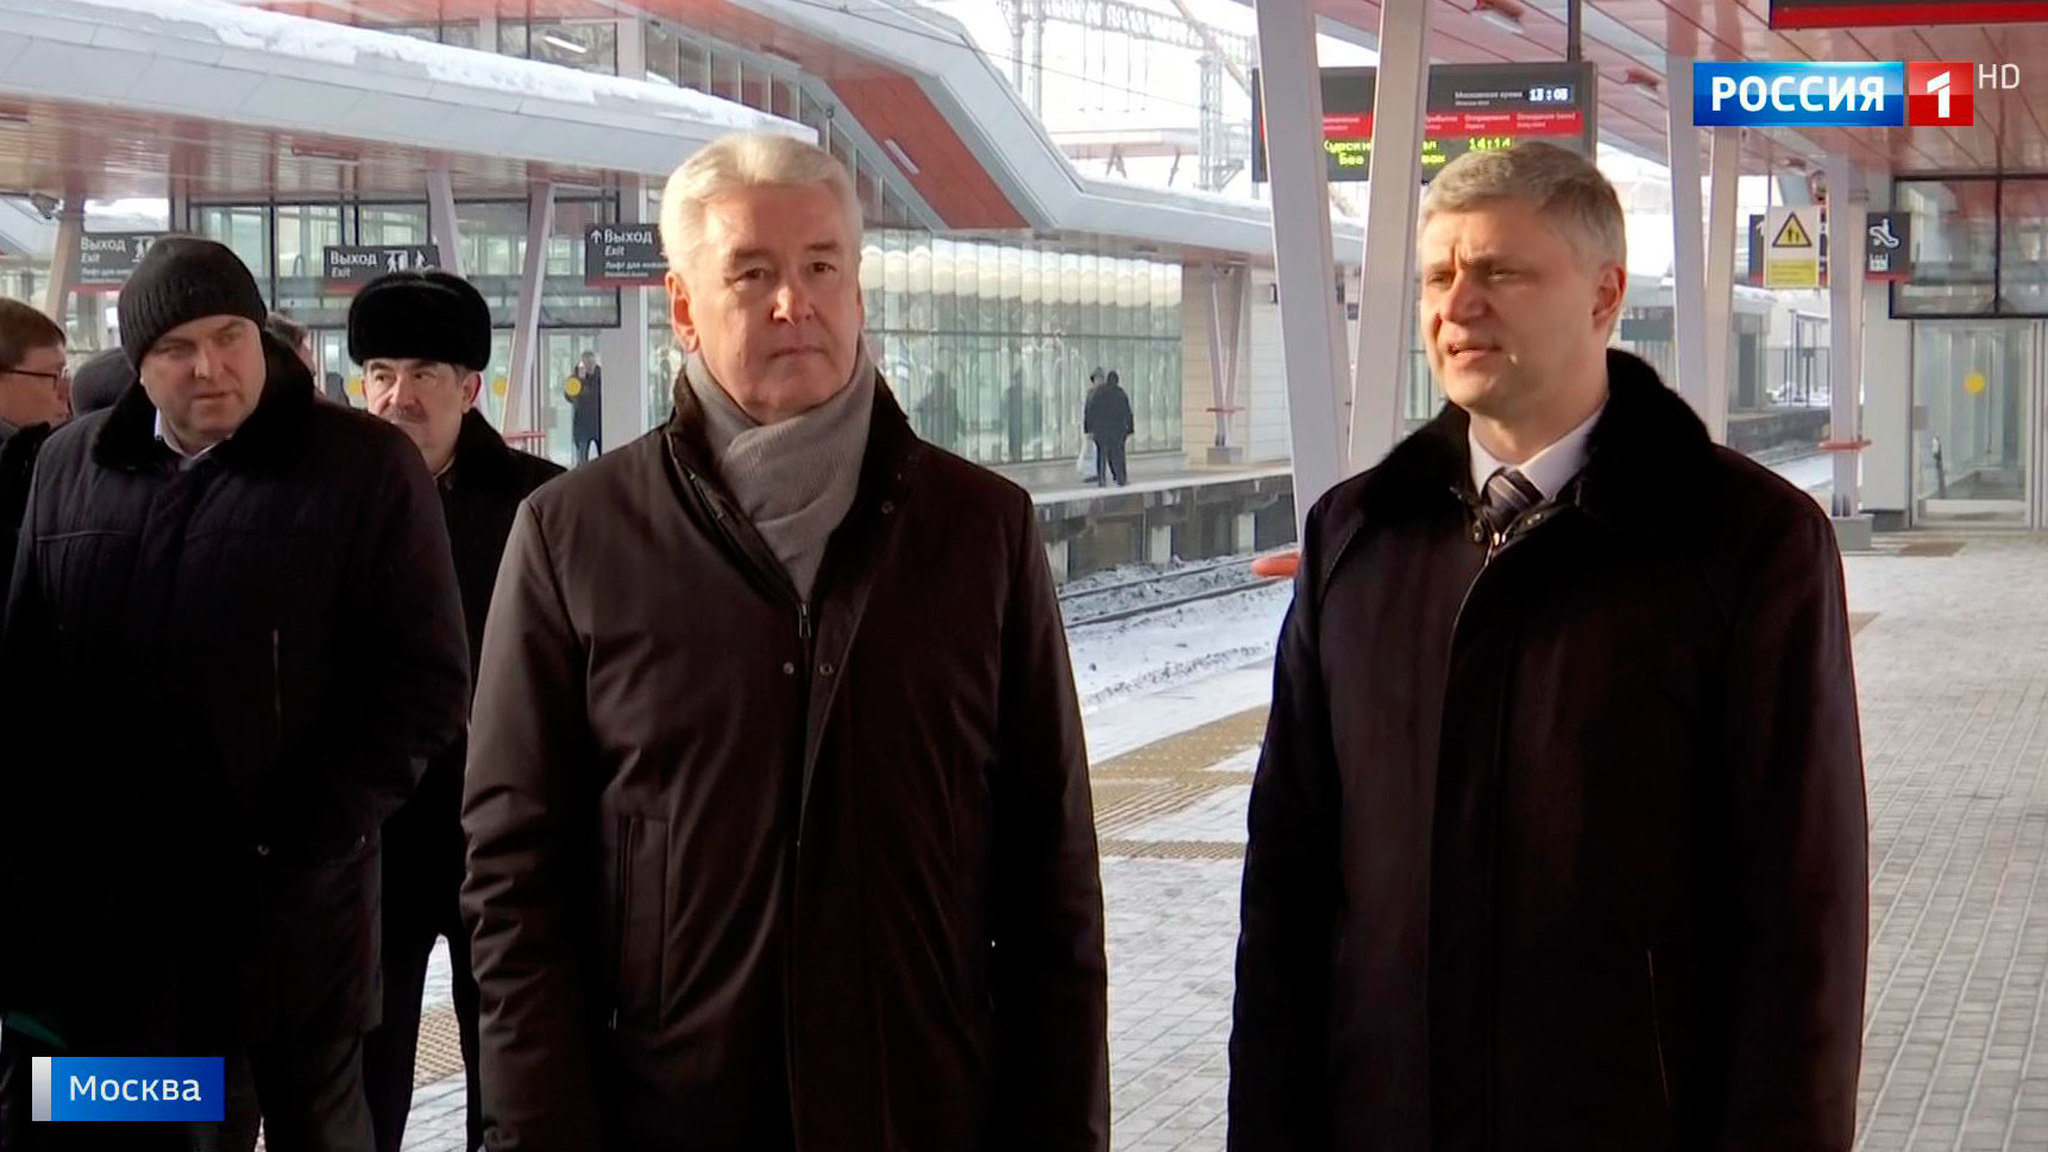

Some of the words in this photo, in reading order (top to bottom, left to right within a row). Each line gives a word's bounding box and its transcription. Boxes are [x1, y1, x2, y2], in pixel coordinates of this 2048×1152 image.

[604, 229, 653, 244] Выход
[81, 237, 126, 252] Выход
[605, 245, 625, 256] Exit
[81, 252, 100, 263] Exit
[331, 250, 378, 267] Выход
[331, 267, 351, 278] Exit
